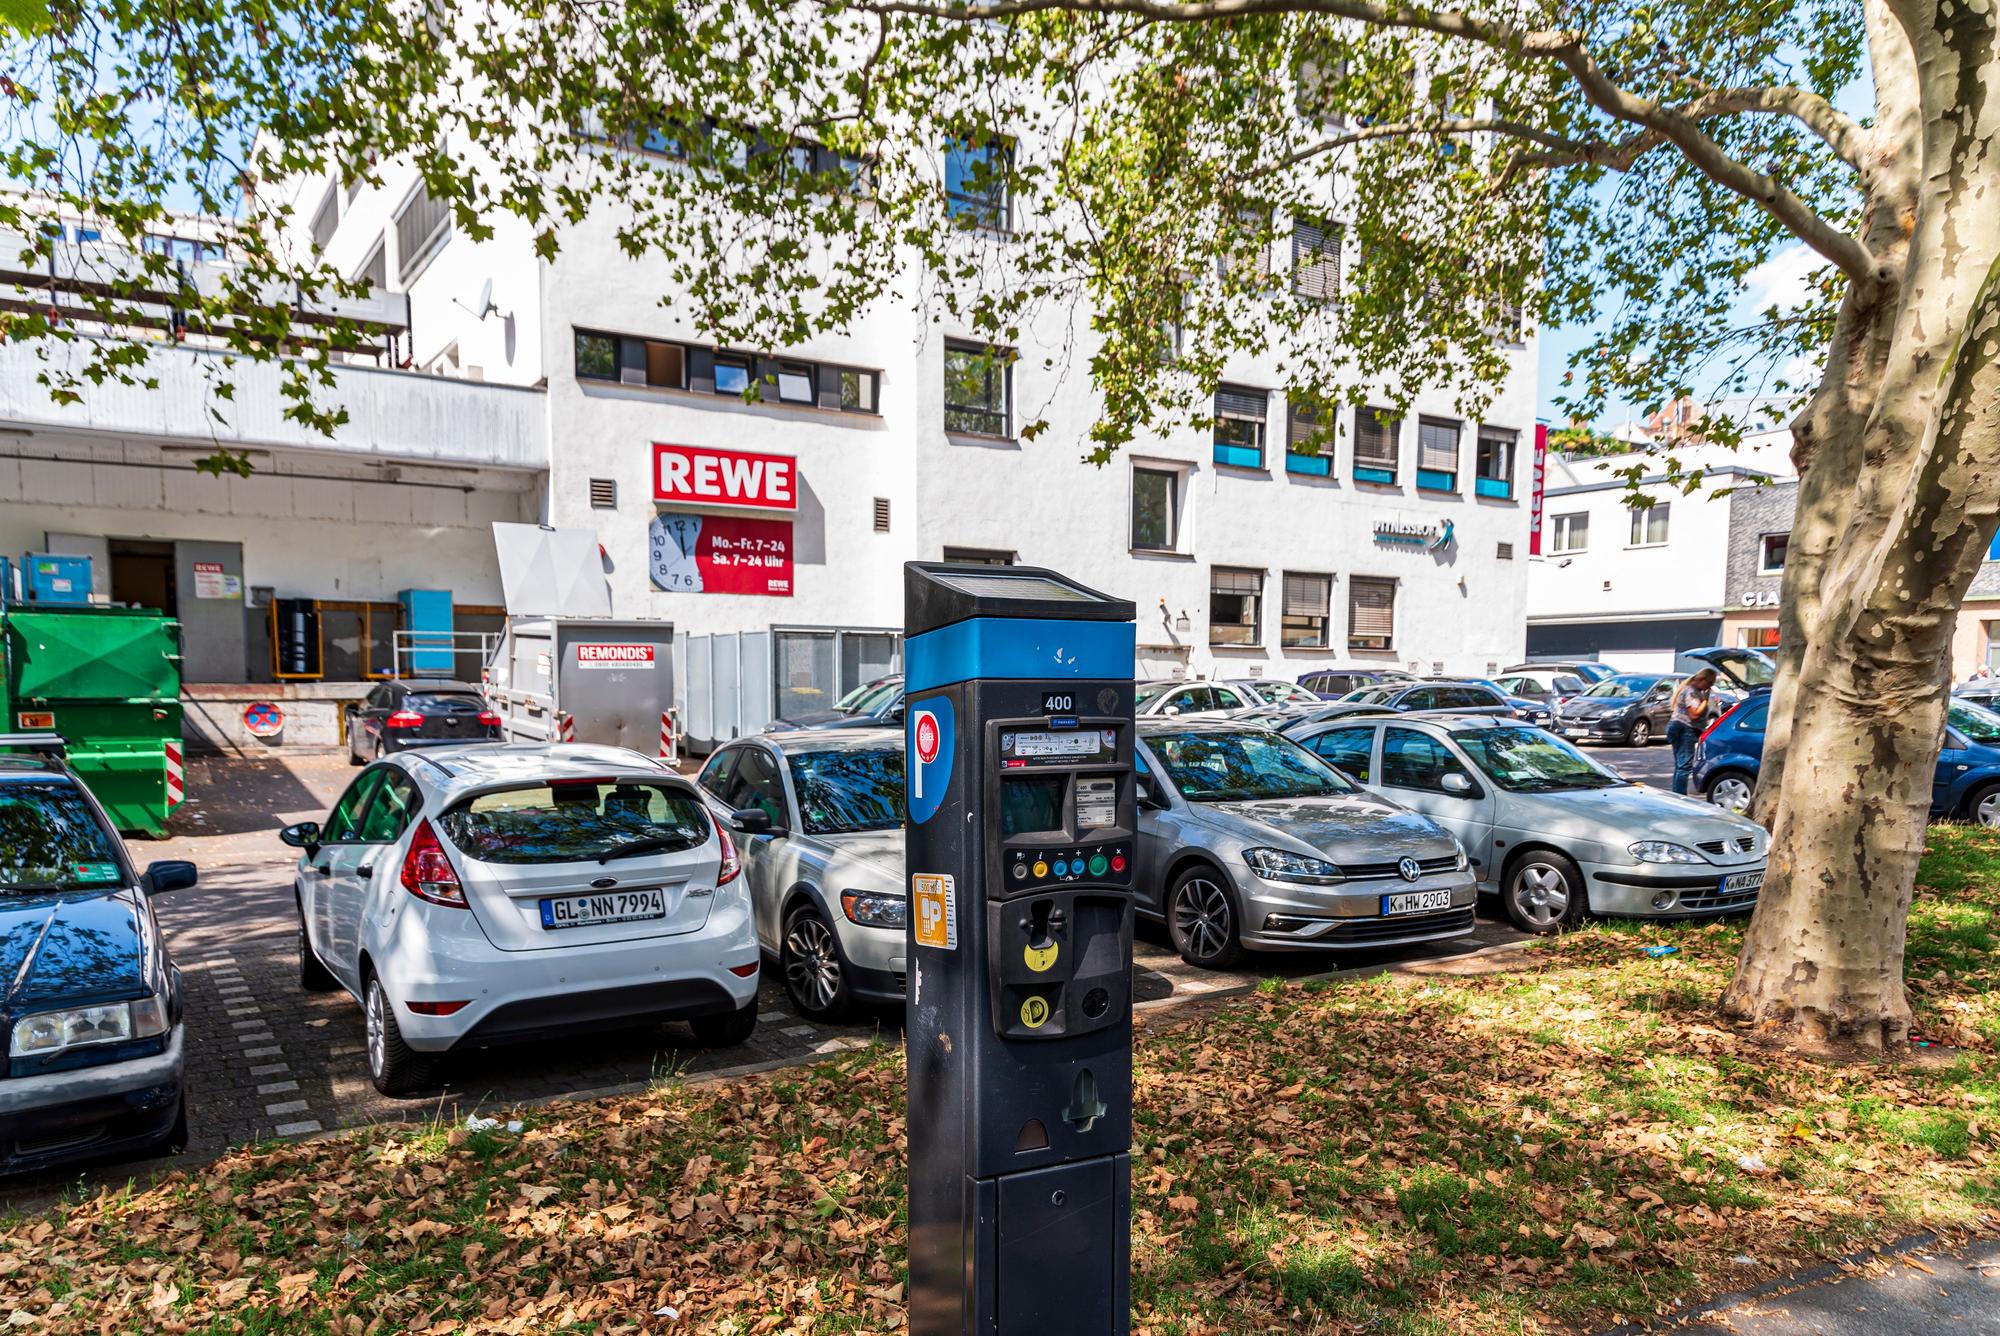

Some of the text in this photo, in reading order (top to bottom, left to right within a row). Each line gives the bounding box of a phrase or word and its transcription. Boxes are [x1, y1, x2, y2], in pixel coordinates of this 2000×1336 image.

[660, 451, 791, 501] REWE
[1531, 448, 1544, 533] REWE
[654, 535, 666, 546] 10
[653, 550, 662, 561] 9
[712, 552, 731, 565] Sa.
[764, 555, 785, 568] Uhr
[659, 564, 668, 575] 8
[672, 574, 679, 584] 7
[684, 575, 693, 586] 6
[579, 646, 648, 660] REMONDIS
[1045, 696, 1072, 710] 400
[1725, 877, 1732, 890] K
[1735, 876, 1746, 888] NA
[554, 901, 579, 921] GL
[591, 896, 615, 917] NN
[617, 892, 662, 915] 7994
[1390, 891, 1449, 911] K HW 2903
